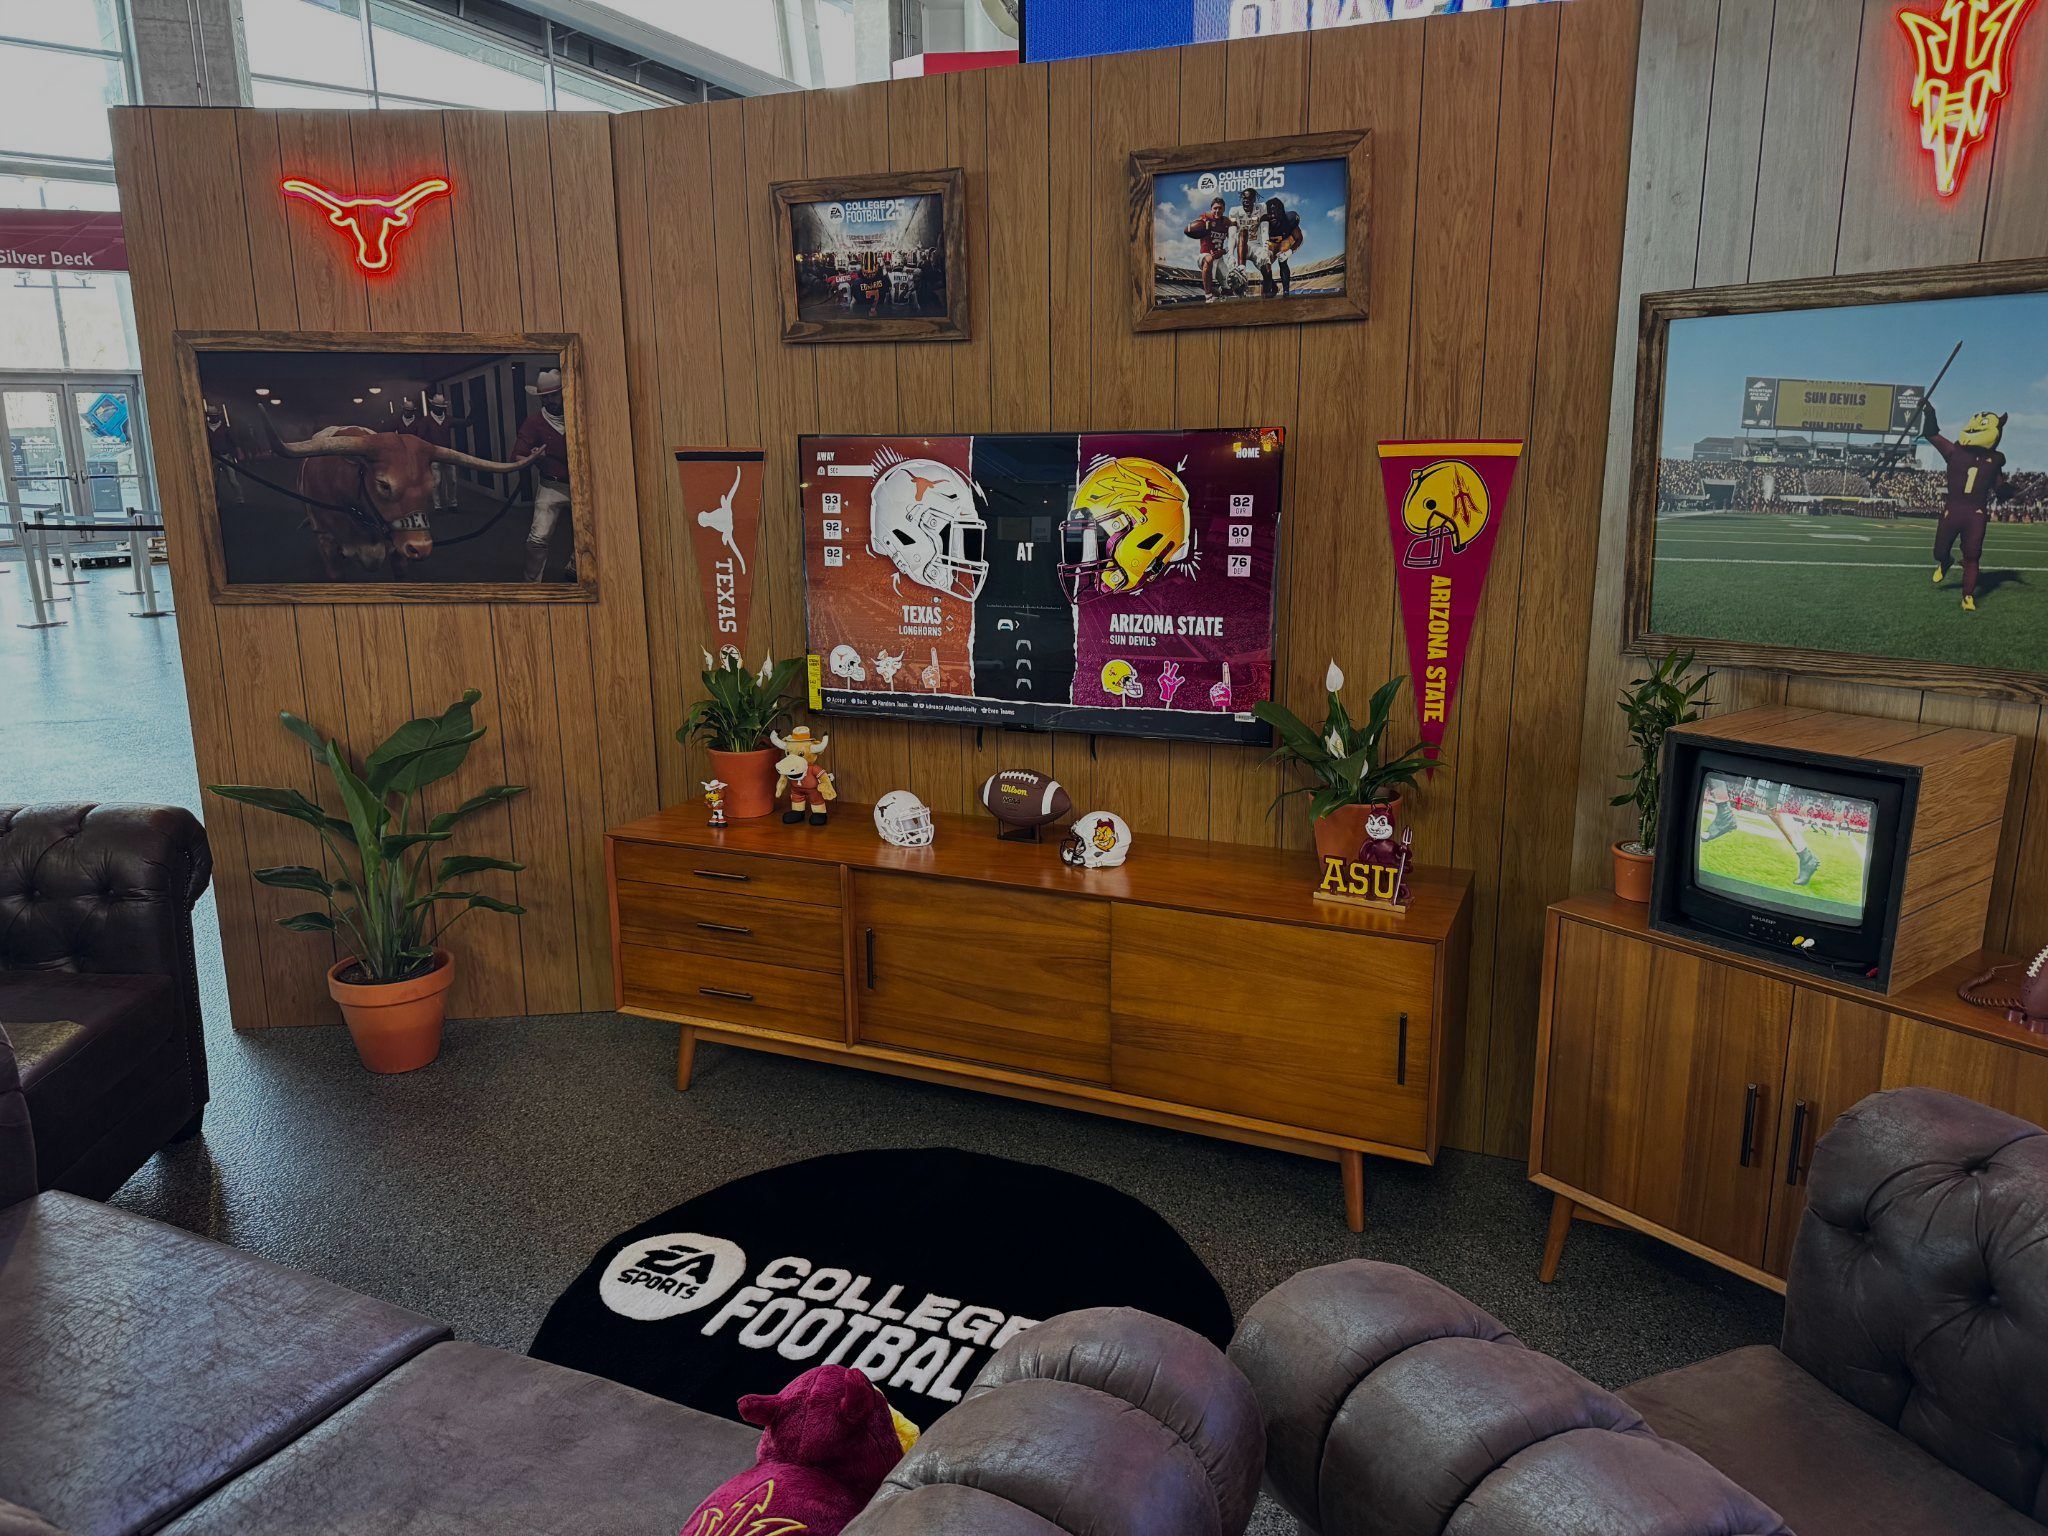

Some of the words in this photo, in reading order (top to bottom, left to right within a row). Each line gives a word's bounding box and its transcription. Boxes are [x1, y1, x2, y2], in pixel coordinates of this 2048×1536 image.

[1218, 168, 1263, 180] COLLEGE
[1262, 167, 1285, 189] 25
[1218, 178, 1262, 193] FOOTBALL
[845, 201, 886, 212] COLLEGE
[885, 199, 905, 220] 25
[845, 208, 886, 224] FOOTBALL
[0, 249, 46, 265] Silver
[50, 251, 94, 266] Deck
[1804, 391, 1827, 404] SUN
[1829, 392, 1867, 406] DEVILS
[816, 451, 835, 461] AWAY
[1235, 447, 1260, 458] HOME
[1964, 467, 1979, 494] 1
[824, 495, 839, 505] 93
[1232, 496, 1250, 507] 82
[825, 522, 839, 531] 92
[1231, 527, 1249, 537] 80
[826, 548, 840, 558] 92
[1016, 542, 1034, 561] AT
[1231, 557, 1248, 568] 76
[715, 557, 737, 633] TEXAS
[902, 605, 942, 625] TEXAS
[1427, 574, 1452, 660] ARIZONA
[898, 625, 942, 637] LONGHORNS
[1109, 613, 1174, 635] ARIZONA
[1177, 616, 1224, 637] STATE
[1109, 634, 1126, 645] SUN
[1128, 636, 1157, 647] DEVILS
[1423, 665, 1447, 723] STATE
[944, 704, 977, 714] Alphabetically
[1000, 783, 1028, 797] Wilson
[1320, 857, 1399, 899] ASU
[635, 1245, 716, 1285] EA
[617, 1268, 701, 1299] SPORTS
[700, 1286, 963, 1403] FOOTBAL
